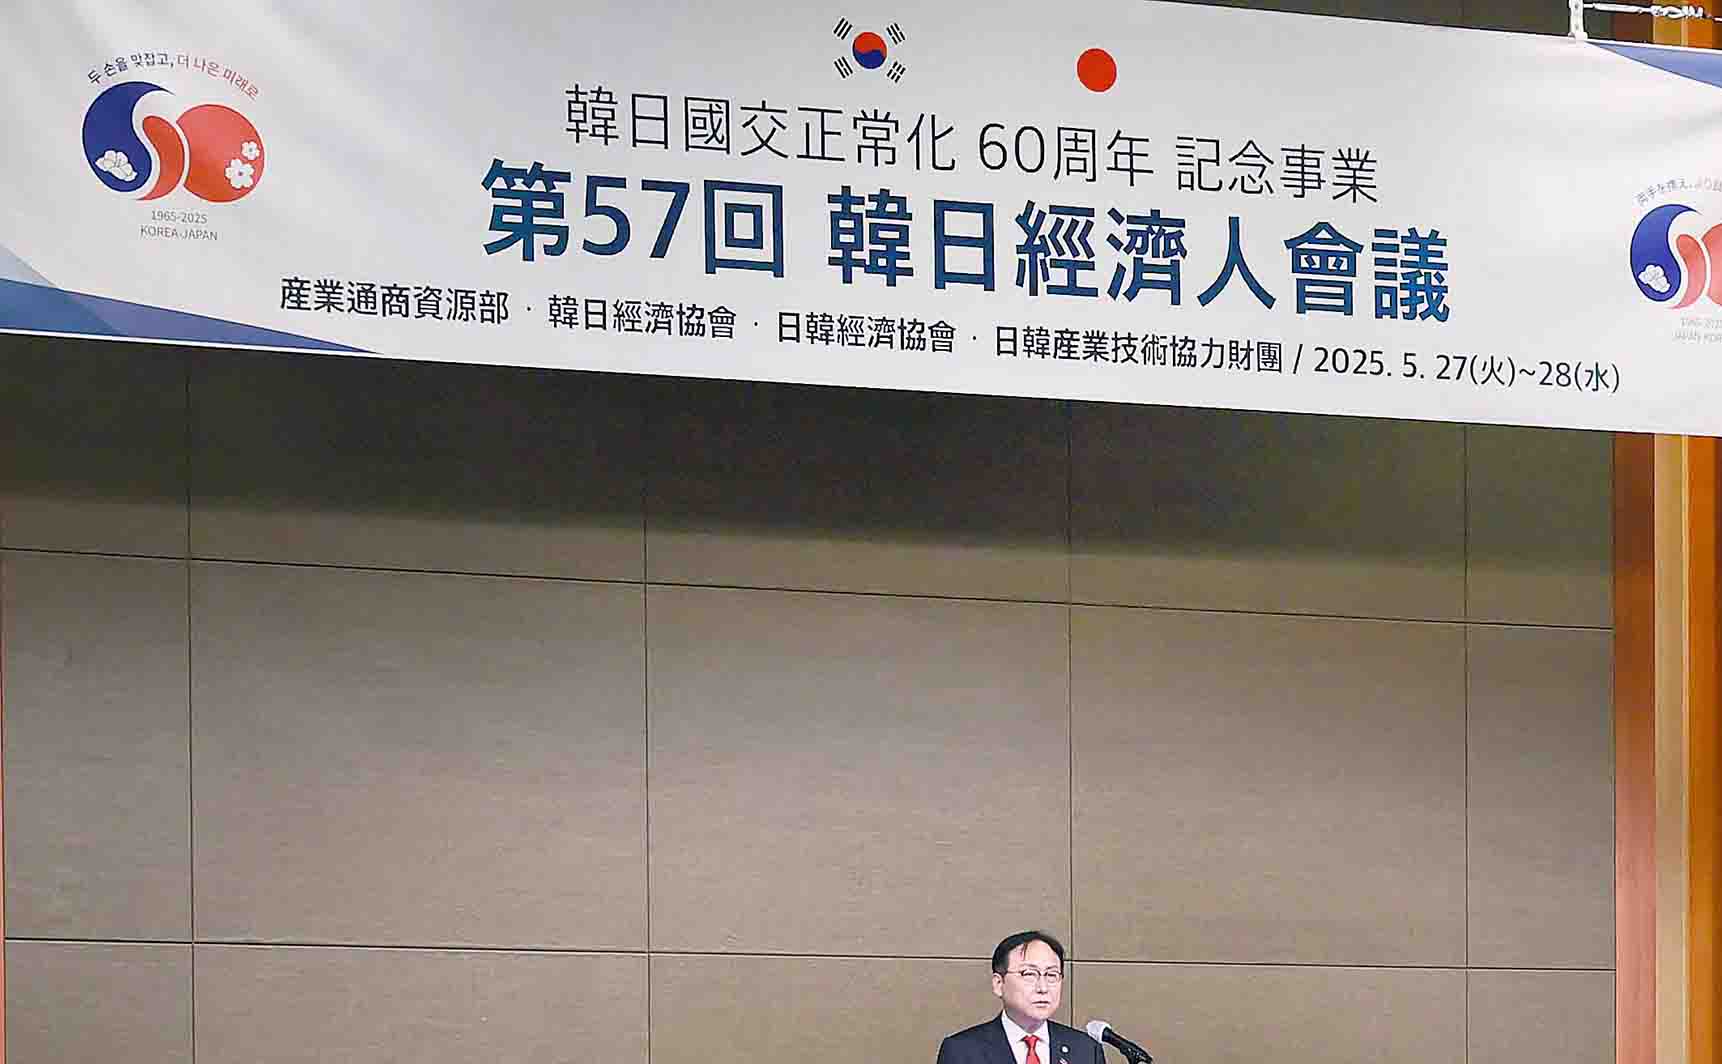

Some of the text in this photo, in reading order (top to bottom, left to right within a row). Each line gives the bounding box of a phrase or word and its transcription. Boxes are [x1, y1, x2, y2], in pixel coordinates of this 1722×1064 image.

[88, 70, 101, 83] 두
[104, 57, 128, 76] 손을
[178, 55, 188, 68] 더
[193, 58, 219, 77] 나은
[223, 69, 259, 98] 미래로
[565, 83, 1377, 203] 韓日國交正常化 60周年 記念事業
[152, 211, 207, 224] 1965-2025
[481, 158, 1449, 323] 第57回 韓日經濟人會議
[281, 277, 508, 324] 産業通商資源部
[549, 295, 736, 338] 韓日經濟協會
[779, 312, 956, 352] 日韓經濟協會
[997, 326, 1281, 373] 日韓産業技術協力財團
[1315, 347, 1391, 376] 2025.
[1403, 353, 1424, 378] 5.
[1437, 355, 1619, 393] 27(火)~28(水)
